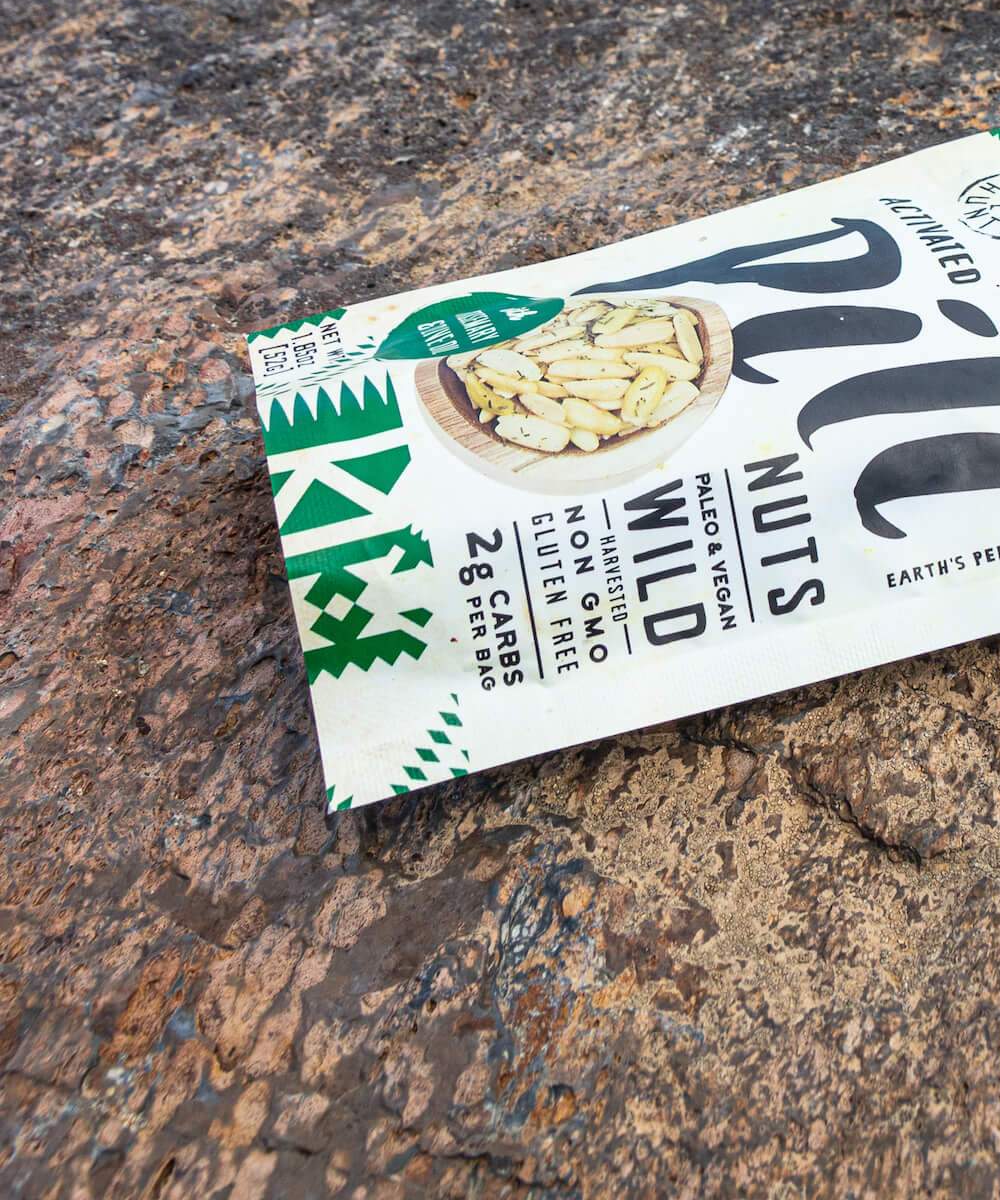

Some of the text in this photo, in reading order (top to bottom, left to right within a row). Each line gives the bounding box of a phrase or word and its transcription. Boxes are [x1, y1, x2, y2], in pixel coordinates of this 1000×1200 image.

[879, 197, 981, 285] ACTIVATED
[319, 322, 341, 346] NET
[455, 309, 500, 344] EMARY
[531, 512, 579, 674] GLUTEN FREE
[564, 505, 608, 664] NON GMO
[600, 535, 628, 622] HARVESTED
[624, 478, 707, 646] WILD
[695, 472, 737, 631] PALEO & VEGAN
[743, 452, 825, 616] NUTS
[886, 555, 966, 588] EARTH'S
[459, 527, 524, 687] 2g CARBS
[466, 597, 496, 691] PER BAG
